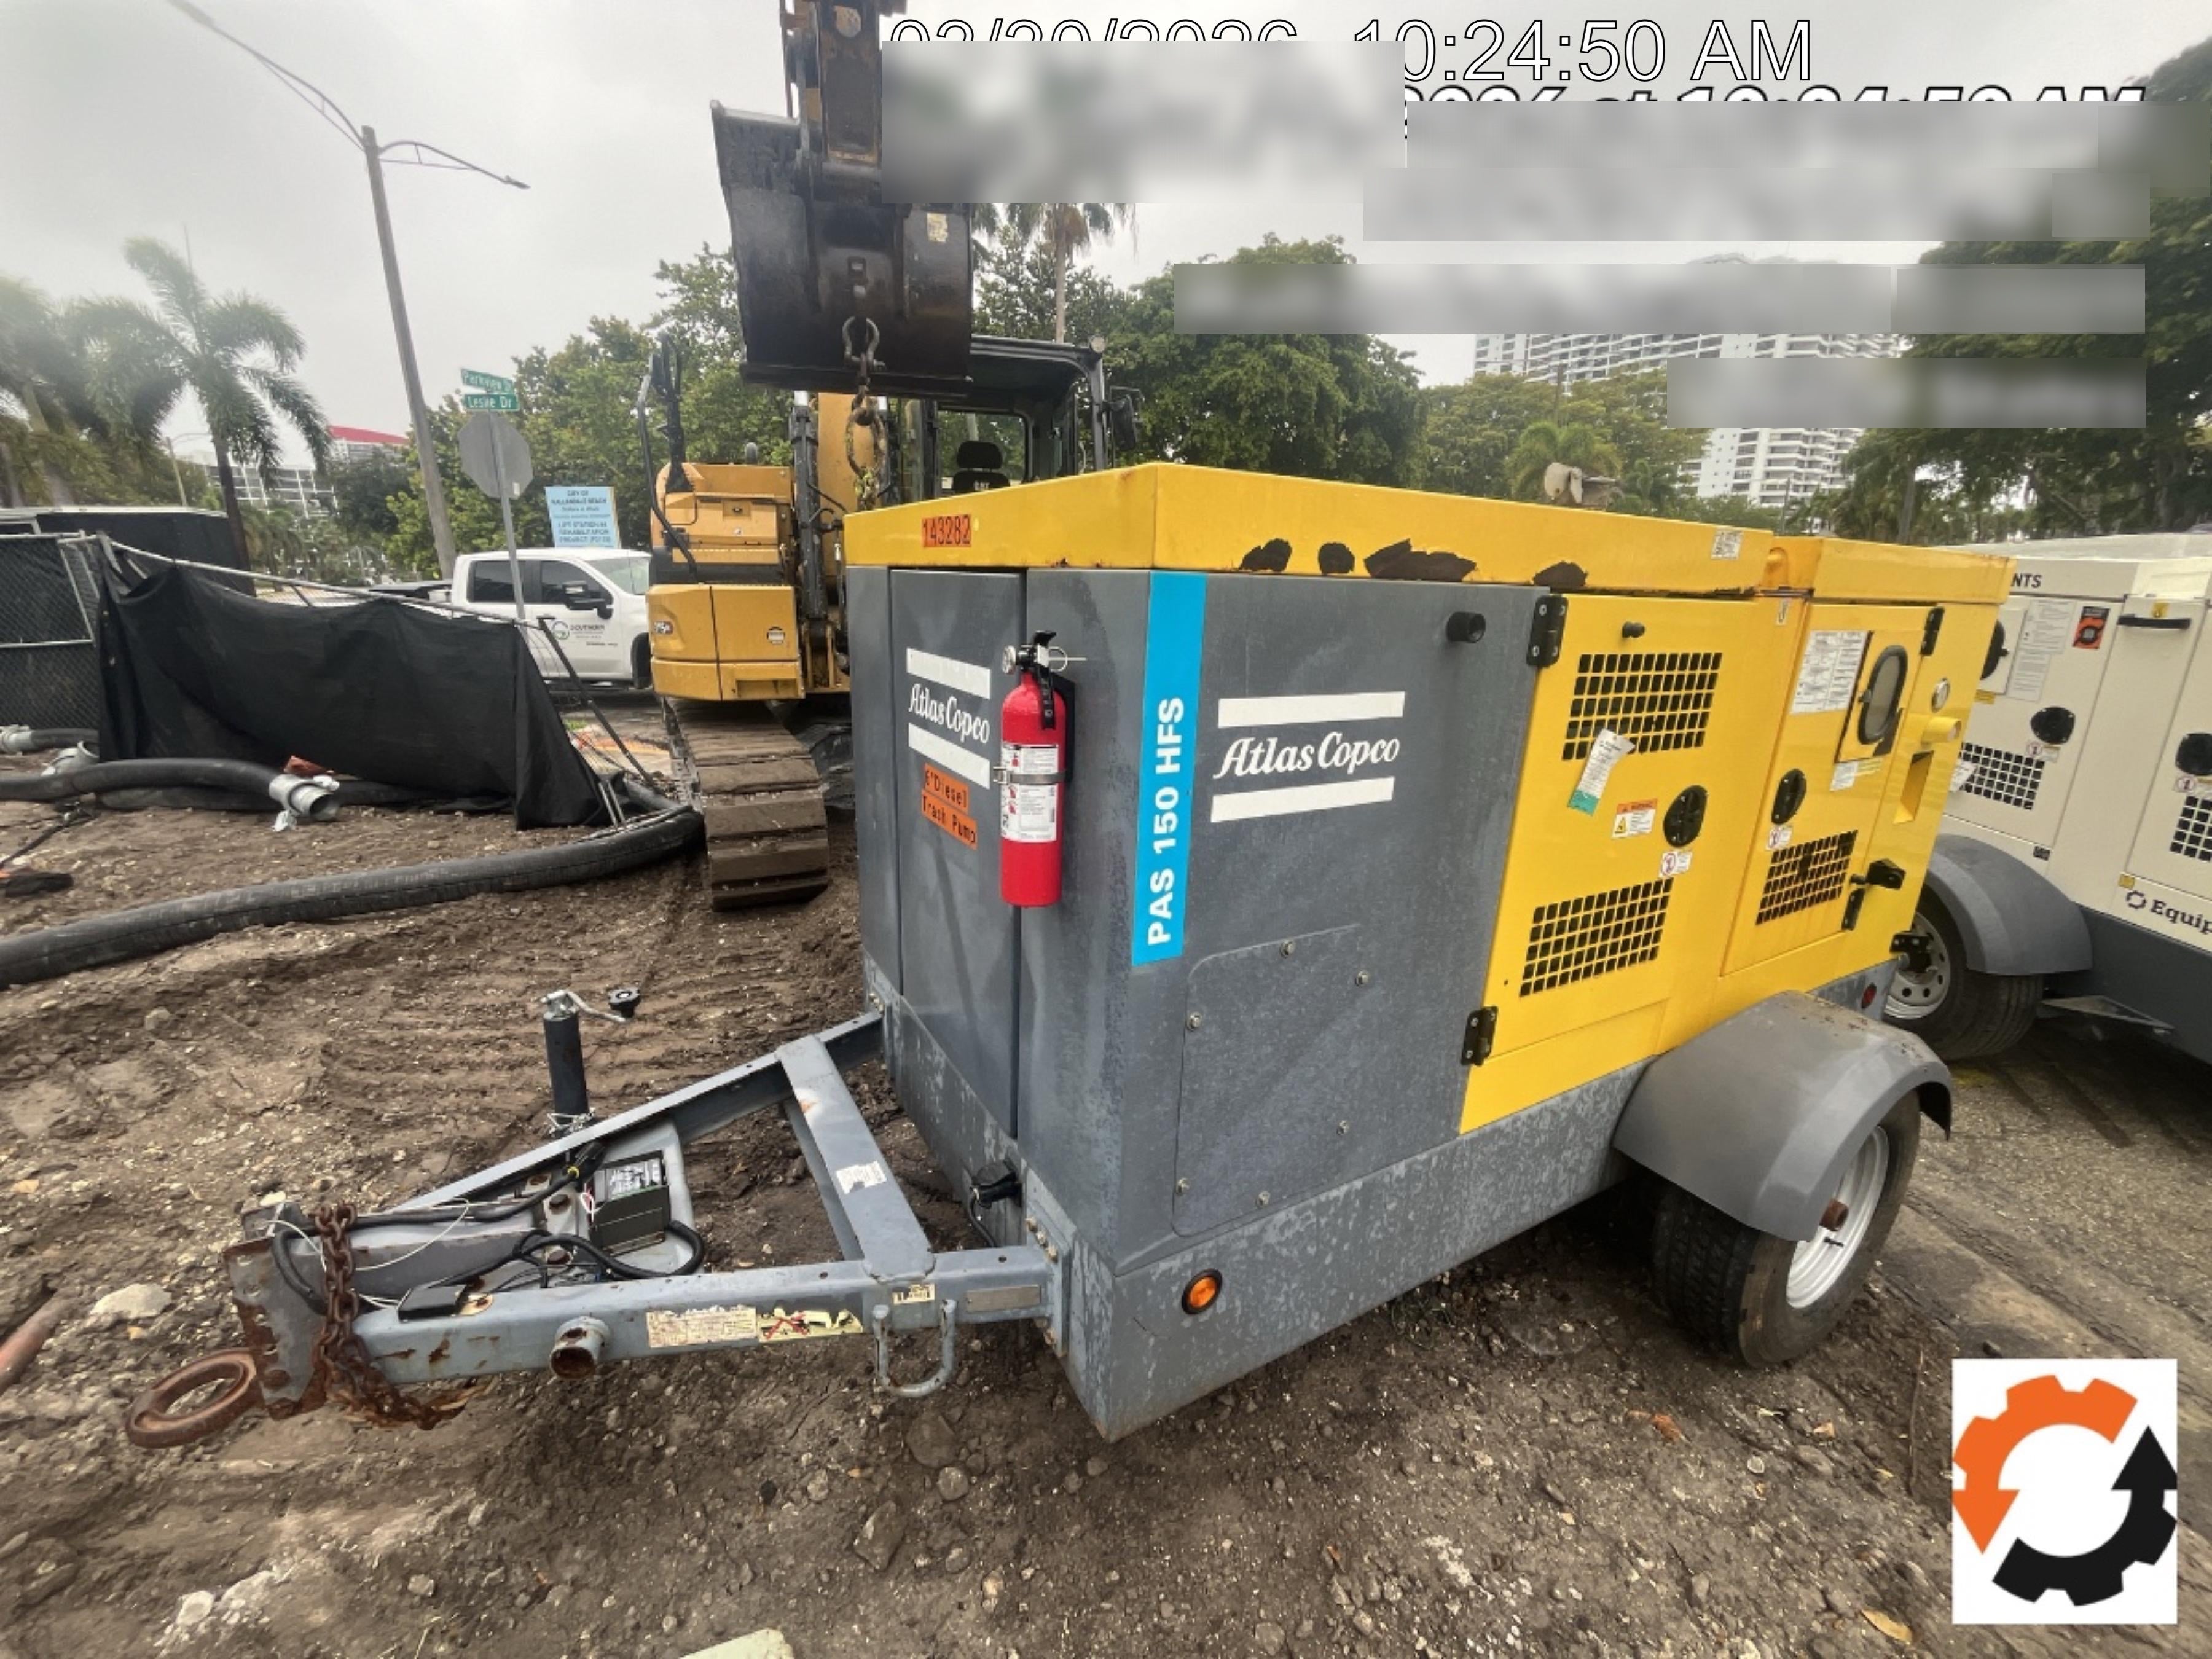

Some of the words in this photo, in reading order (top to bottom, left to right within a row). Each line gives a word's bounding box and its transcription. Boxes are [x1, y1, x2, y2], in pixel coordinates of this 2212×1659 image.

[500, 396, 512, 408] Dr
[922, 514, 971, 545] 143282
[908, 683, 945, 726] Atlas
[946, 695, 990, 744] Copco
[1155, 697, 1185, 774] HFS
[1213, 737, 1314, 779] Atlas
[1317, 731, 1400, 774] Copco
[922, 795, 947, 824] Trash
[952, 814, 977, 844] Pump
[1153, 786, 1179, 855] 150
[1148, 867, 1175, 946] PAS
